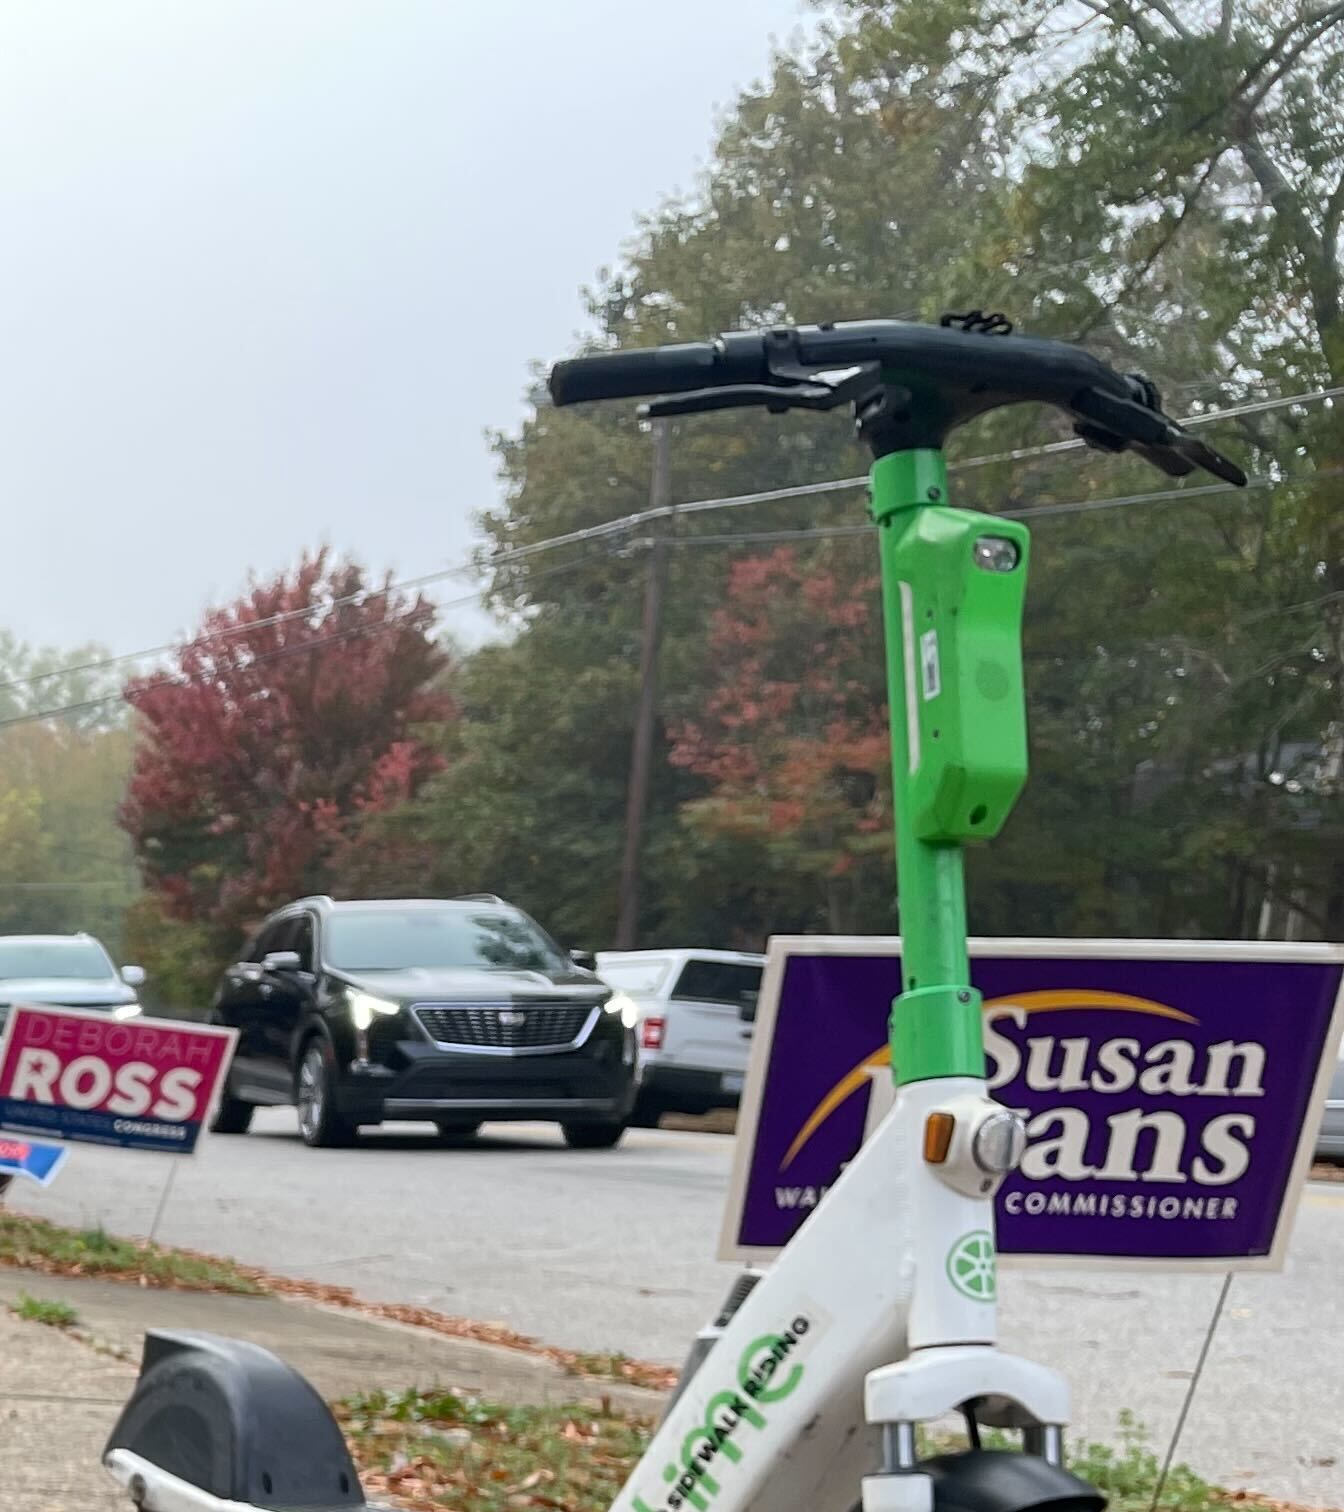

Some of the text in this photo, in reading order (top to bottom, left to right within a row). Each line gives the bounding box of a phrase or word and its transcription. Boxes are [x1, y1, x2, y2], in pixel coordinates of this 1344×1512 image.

[24, 1014, 213, 1064] DEBORAH
[983, 1004, 1267, 1097] Susan
[9, 1046, 204, 1123] ROSS
[114, 1119, 186, 1140] CONGRESS
[1005, 1191, 1238, 1220] COMMISSIONER
[667, 1394, 751, 1511] SIDEWALK
[744, 1317, 810, 1399] RIDING
